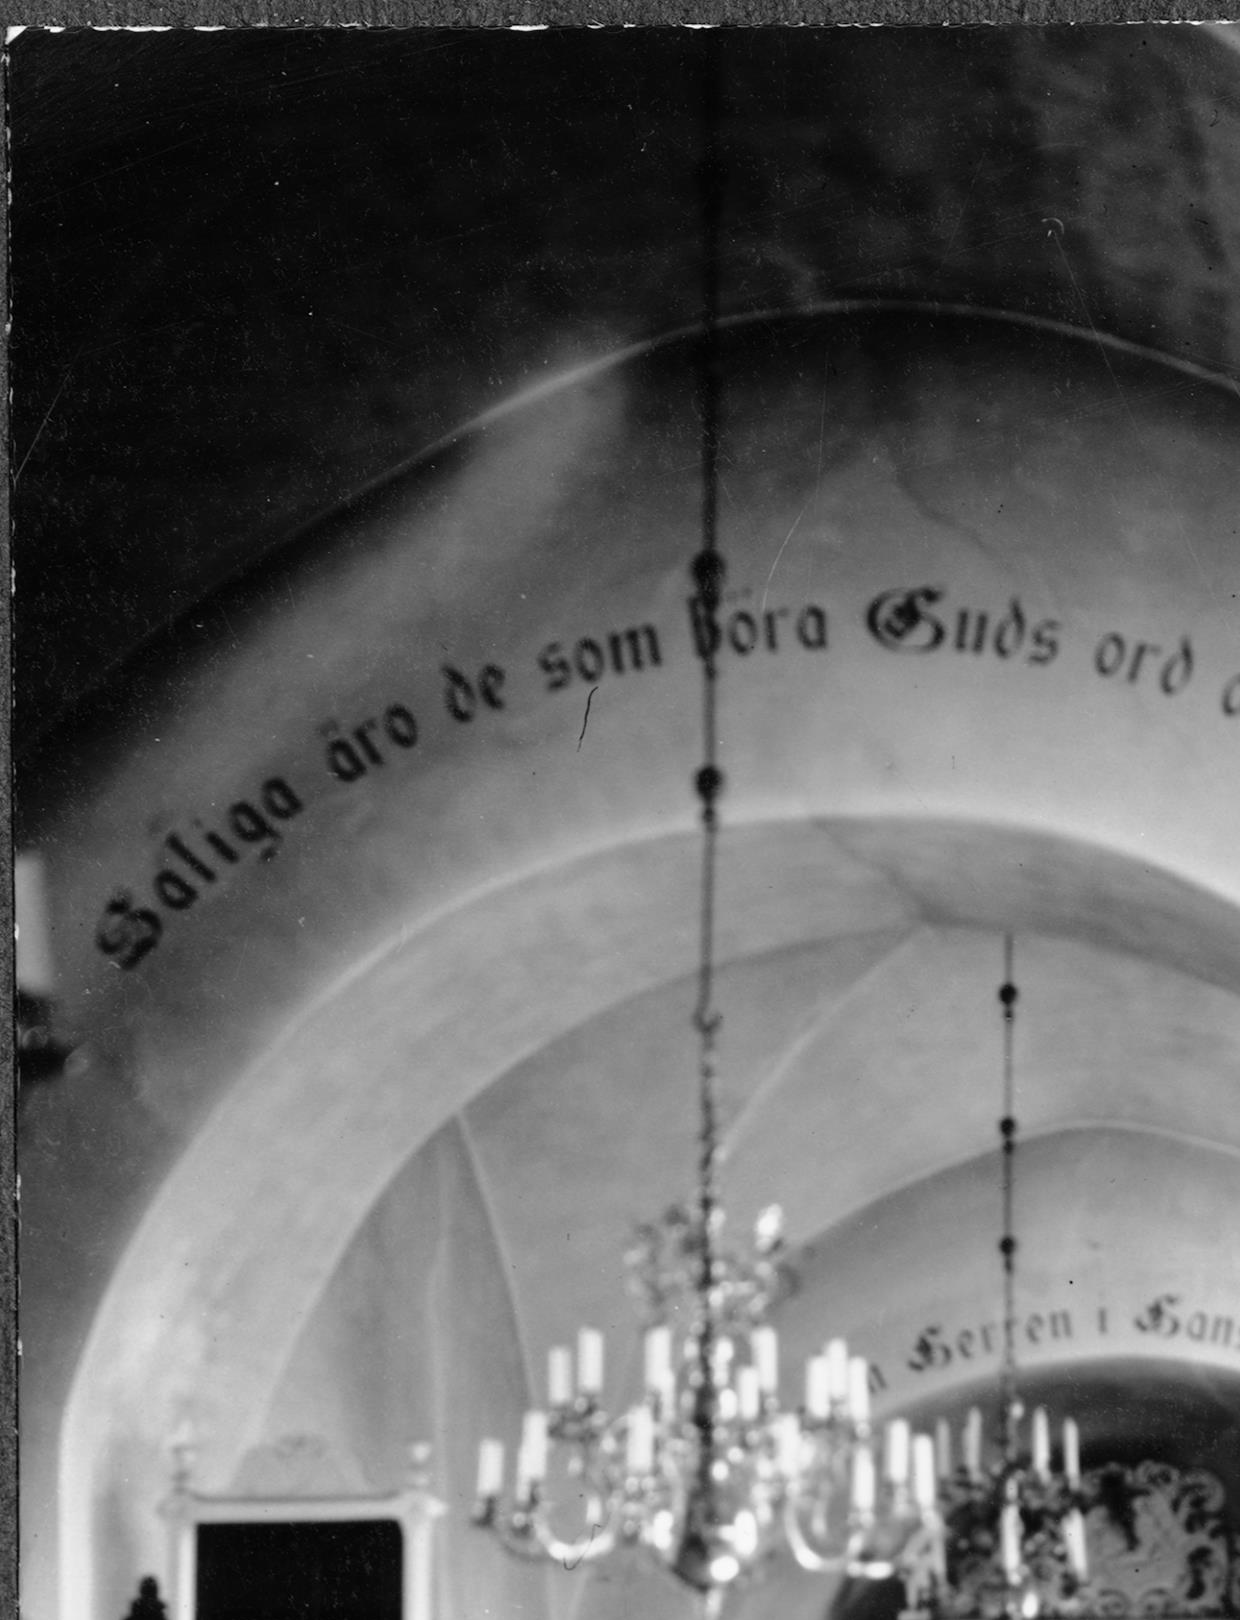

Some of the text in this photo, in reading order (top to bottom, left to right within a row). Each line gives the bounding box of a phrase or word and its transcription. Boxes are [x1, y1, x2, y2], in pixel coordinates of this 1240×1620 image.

[96, 776, 304, 971] Saliga
[317, 703, 418, 783] äro
[441, 663, 506, 724] de
[538, 622, 663, 692] som
[866, 584, 1063, 667] Guds
[1094, 631, 1195, 697] ord
